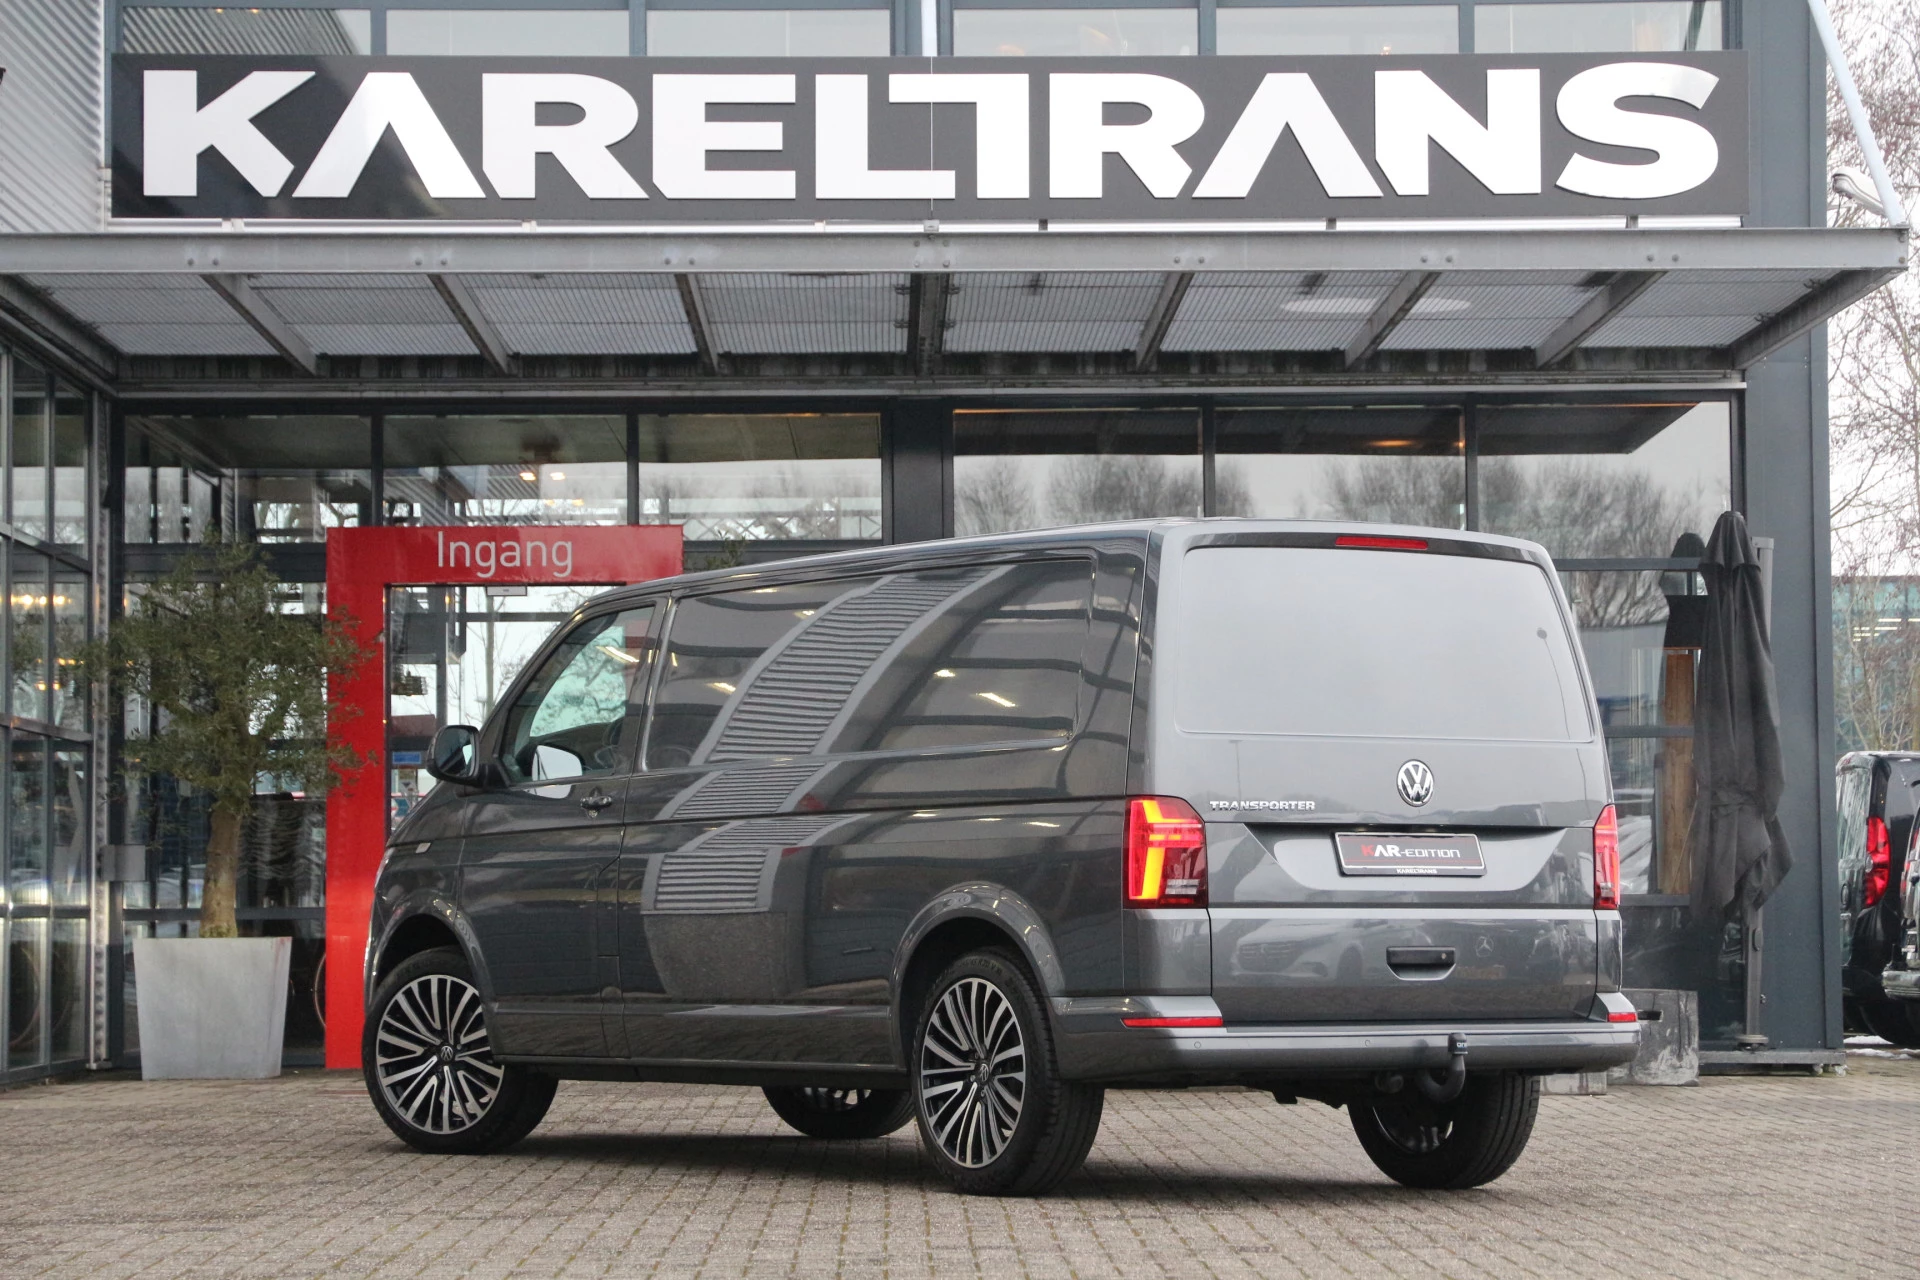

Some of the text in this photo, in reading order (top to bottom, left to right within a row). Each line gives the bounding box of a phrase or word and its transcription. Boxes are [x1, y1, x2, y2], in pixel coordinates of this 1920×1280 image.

[142, 61, 1720, 200] KARELTRANS
[437, 530, 572, 578] Ingang
[1209, 800, 1316, 811] TRANSPORTER
